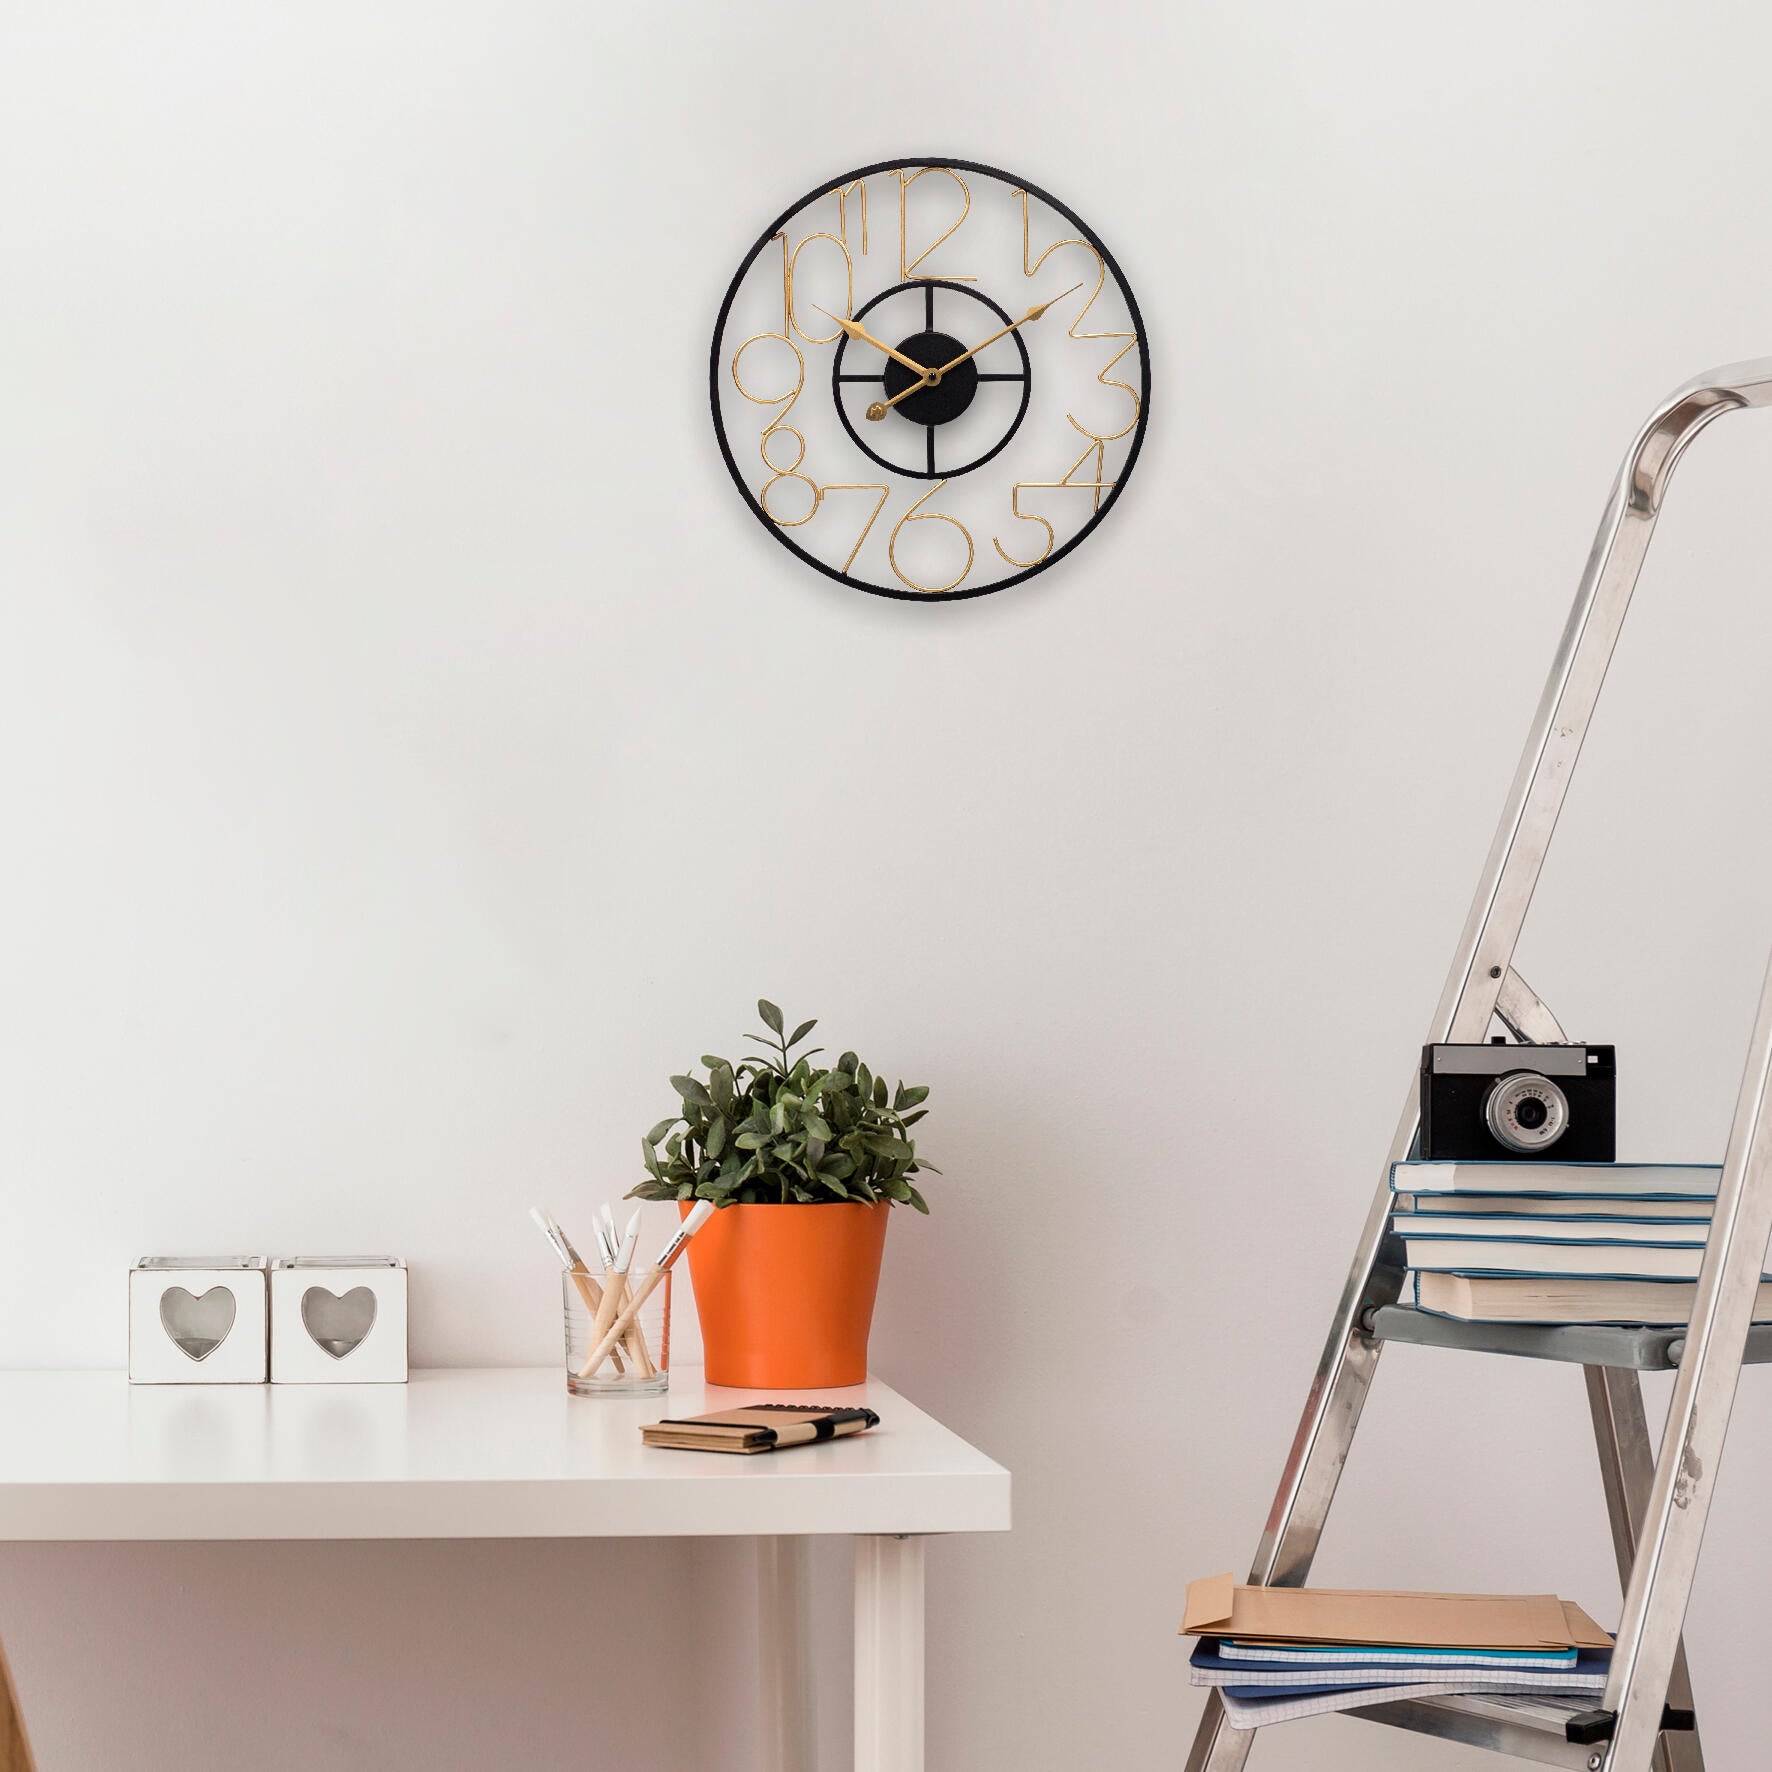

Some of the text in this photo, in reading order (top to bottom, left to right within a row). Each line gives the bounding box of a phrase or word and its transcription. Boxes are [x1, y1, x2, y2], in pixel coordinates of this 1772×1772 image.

[829, 179, 867, 255] 11
[888, 166, 978, 282] 12
[1011, 189, 1033, 276] 1
[771, 232, 853, 344] 10
[1025, 239, 1136, 338] 2
[733, 333, 804, 435] 9
[1067, 333, 1140, 440] 3
[761, 426, 819, 526] 8
[992, 483, 1056, 567] 5
[1059, 439, 1117, 513] 4
[818, 484, 889, 574] 7
[889, 479, 974, 593] 6
